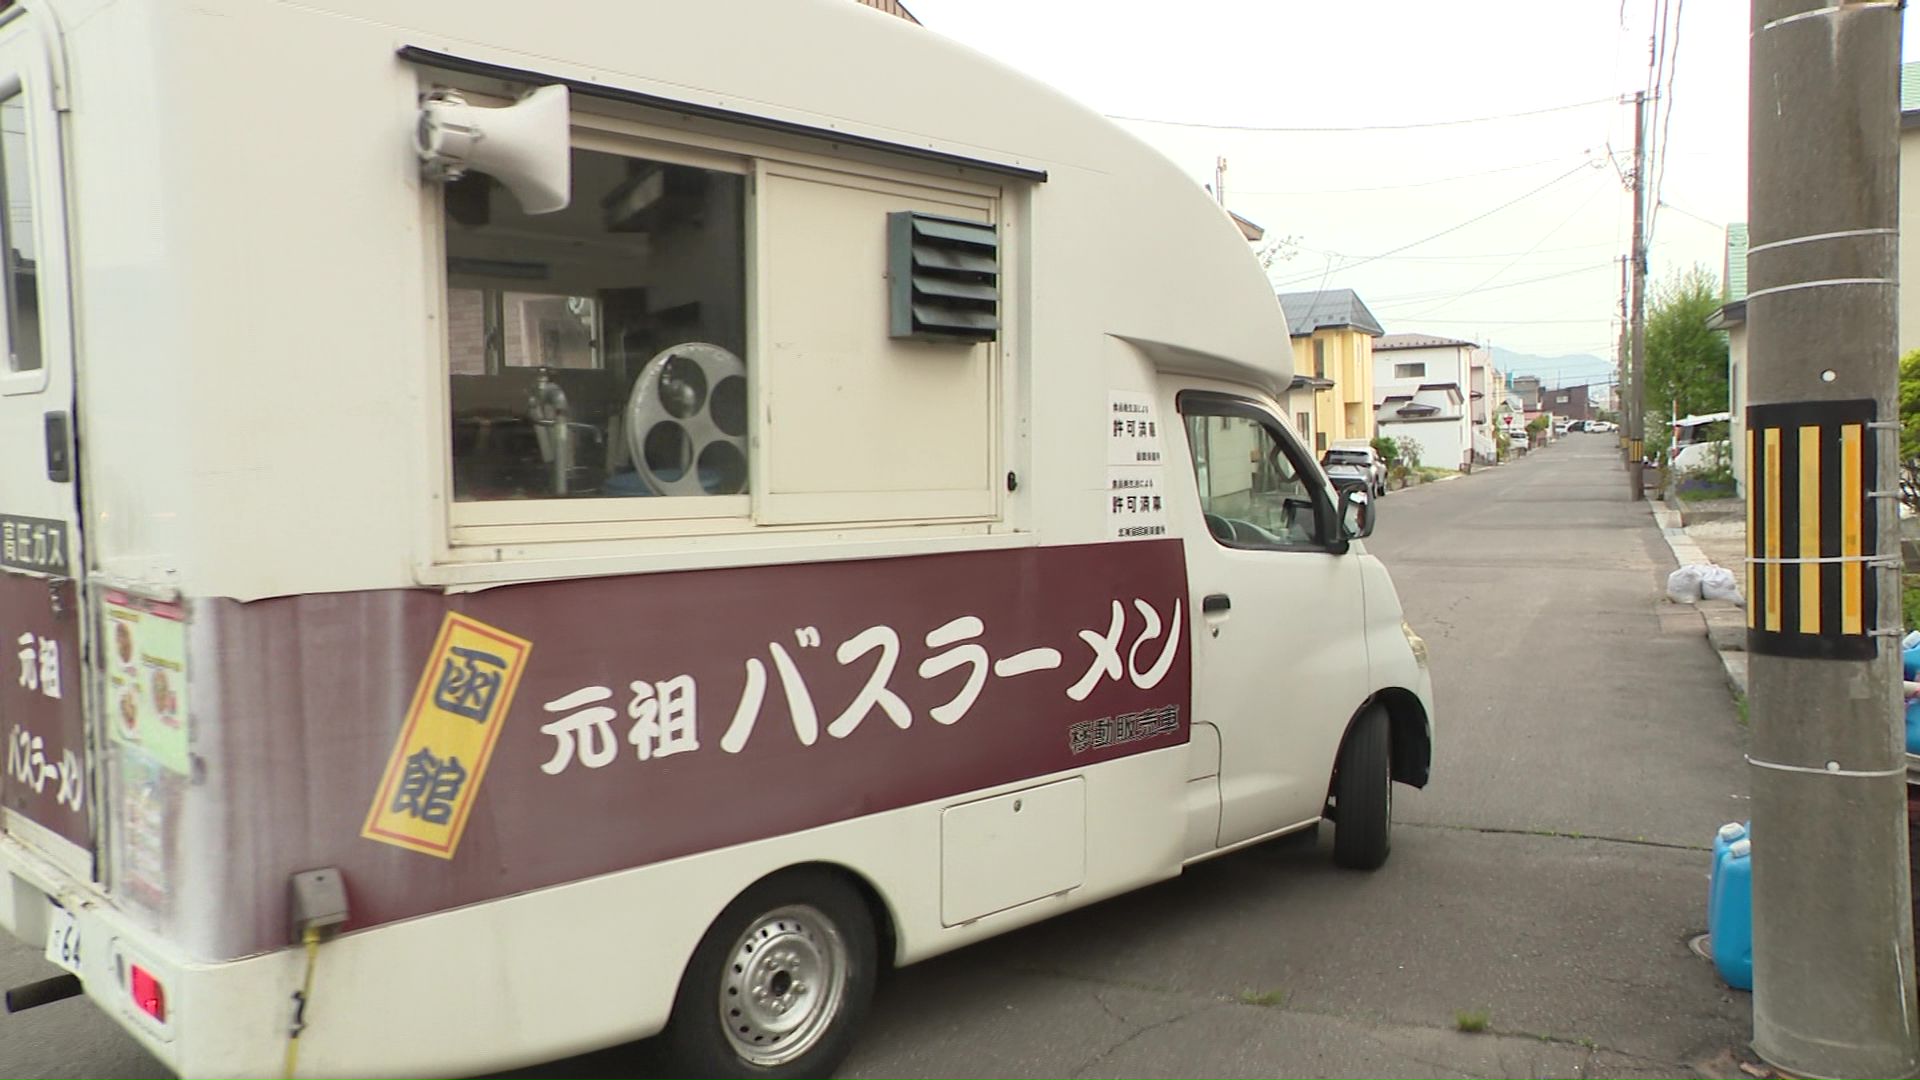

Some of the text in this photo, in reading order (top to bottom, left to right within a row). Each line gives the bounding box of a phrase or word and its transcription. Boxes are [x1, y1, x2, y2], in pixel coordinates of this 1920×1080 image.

[1113, 420, 1156, 437] 許可済車
[1112, 496, 1161, 513] 許可済車
[2, 522, 64, 566] 高圧ガス
[18, 631, 62, 699] 元祖
[391, 645, 506, 827] 函館
